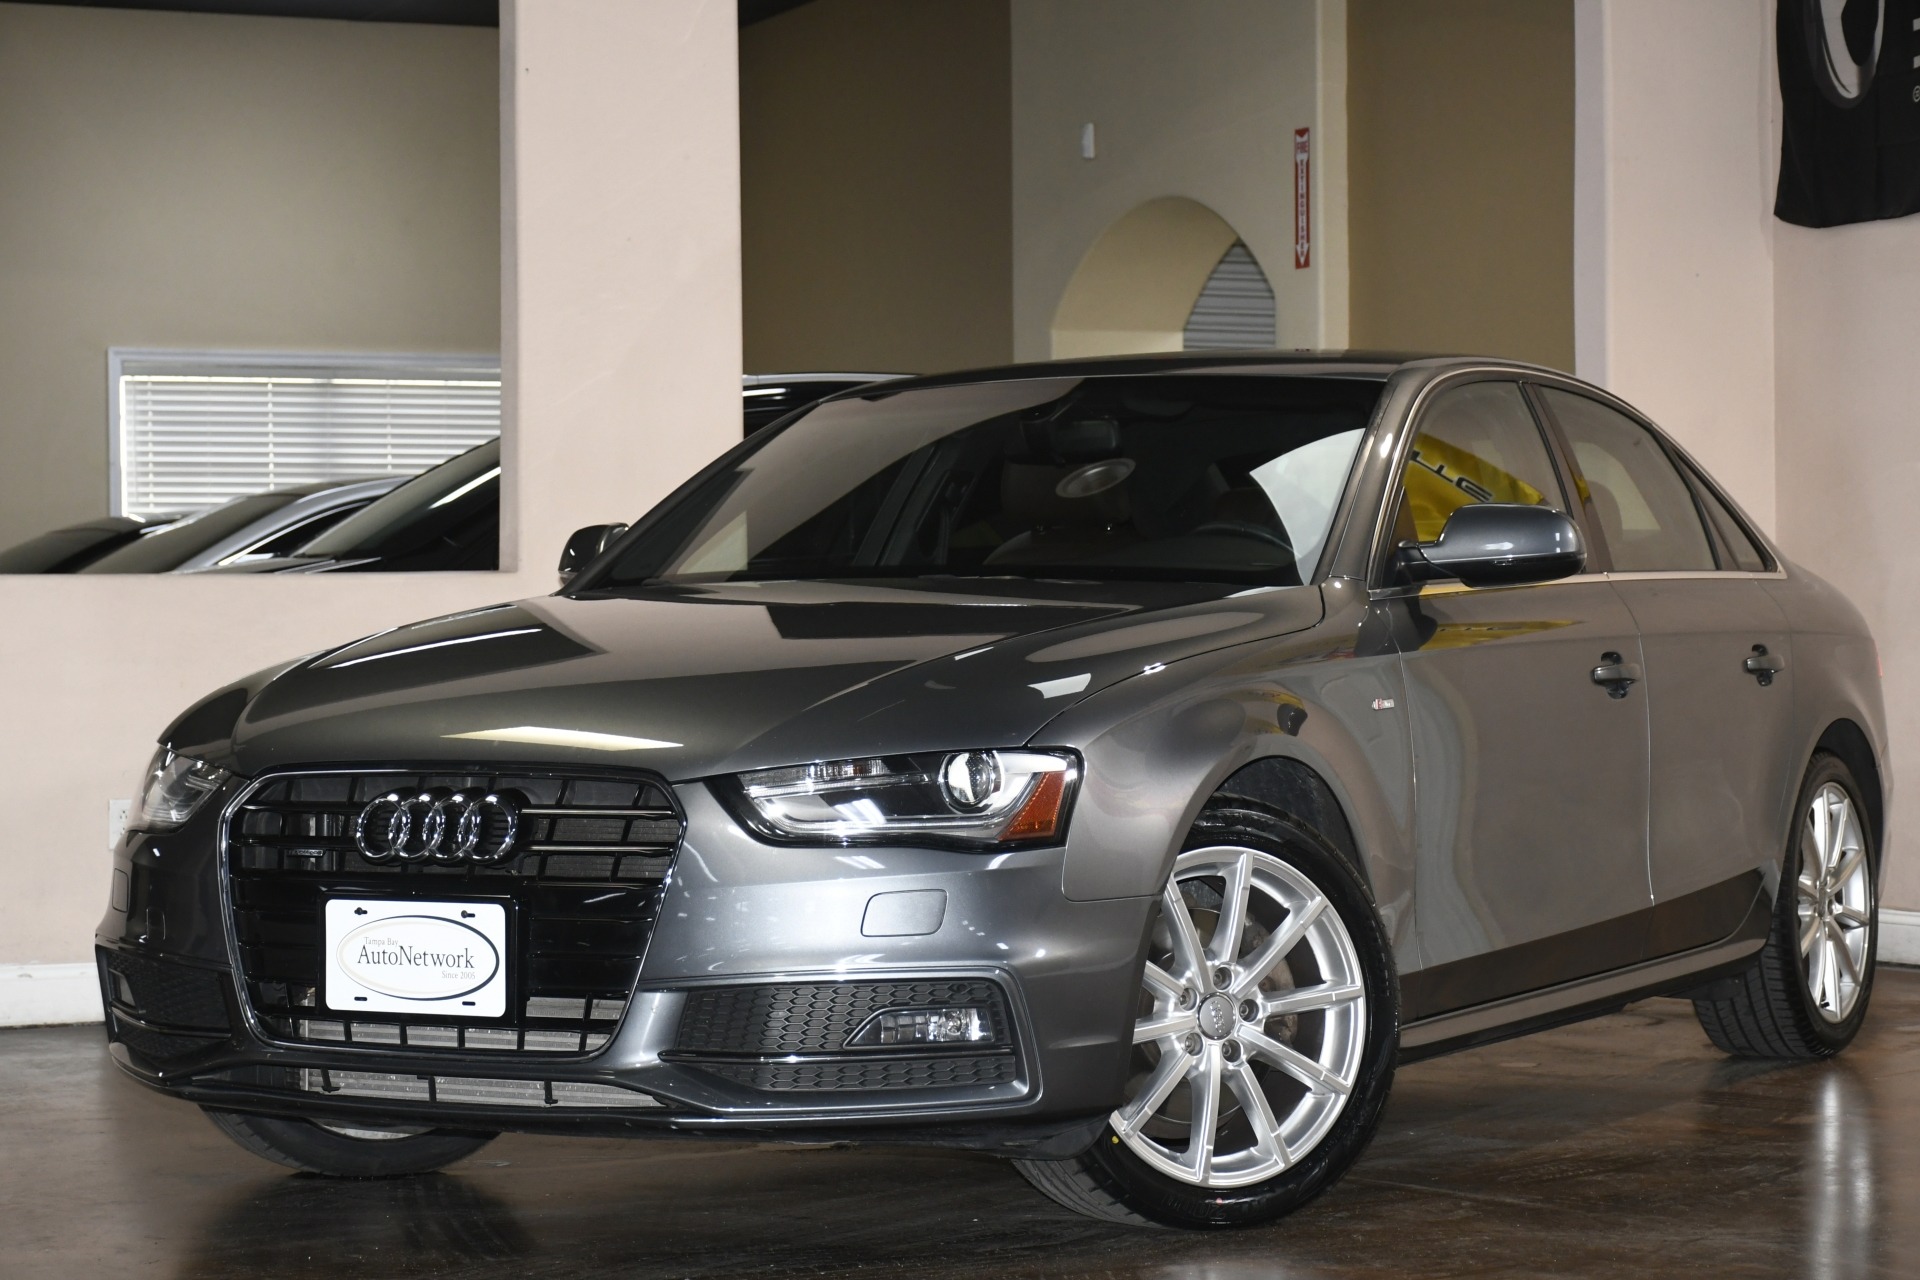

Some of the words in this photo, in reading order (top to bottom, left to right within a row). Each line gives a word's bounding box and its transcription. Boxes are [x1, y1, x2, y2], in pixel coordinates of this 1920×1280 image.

[1296, 141, 1308, 154] FIRE
[364, 936, 386, 948] Tampa
[387, 937, 399, 947] Bay
[358, 944, 475, 969] AutoNetwork
[441, 970, 458, 980] Since
[460, 971, 476, 980] 2005
